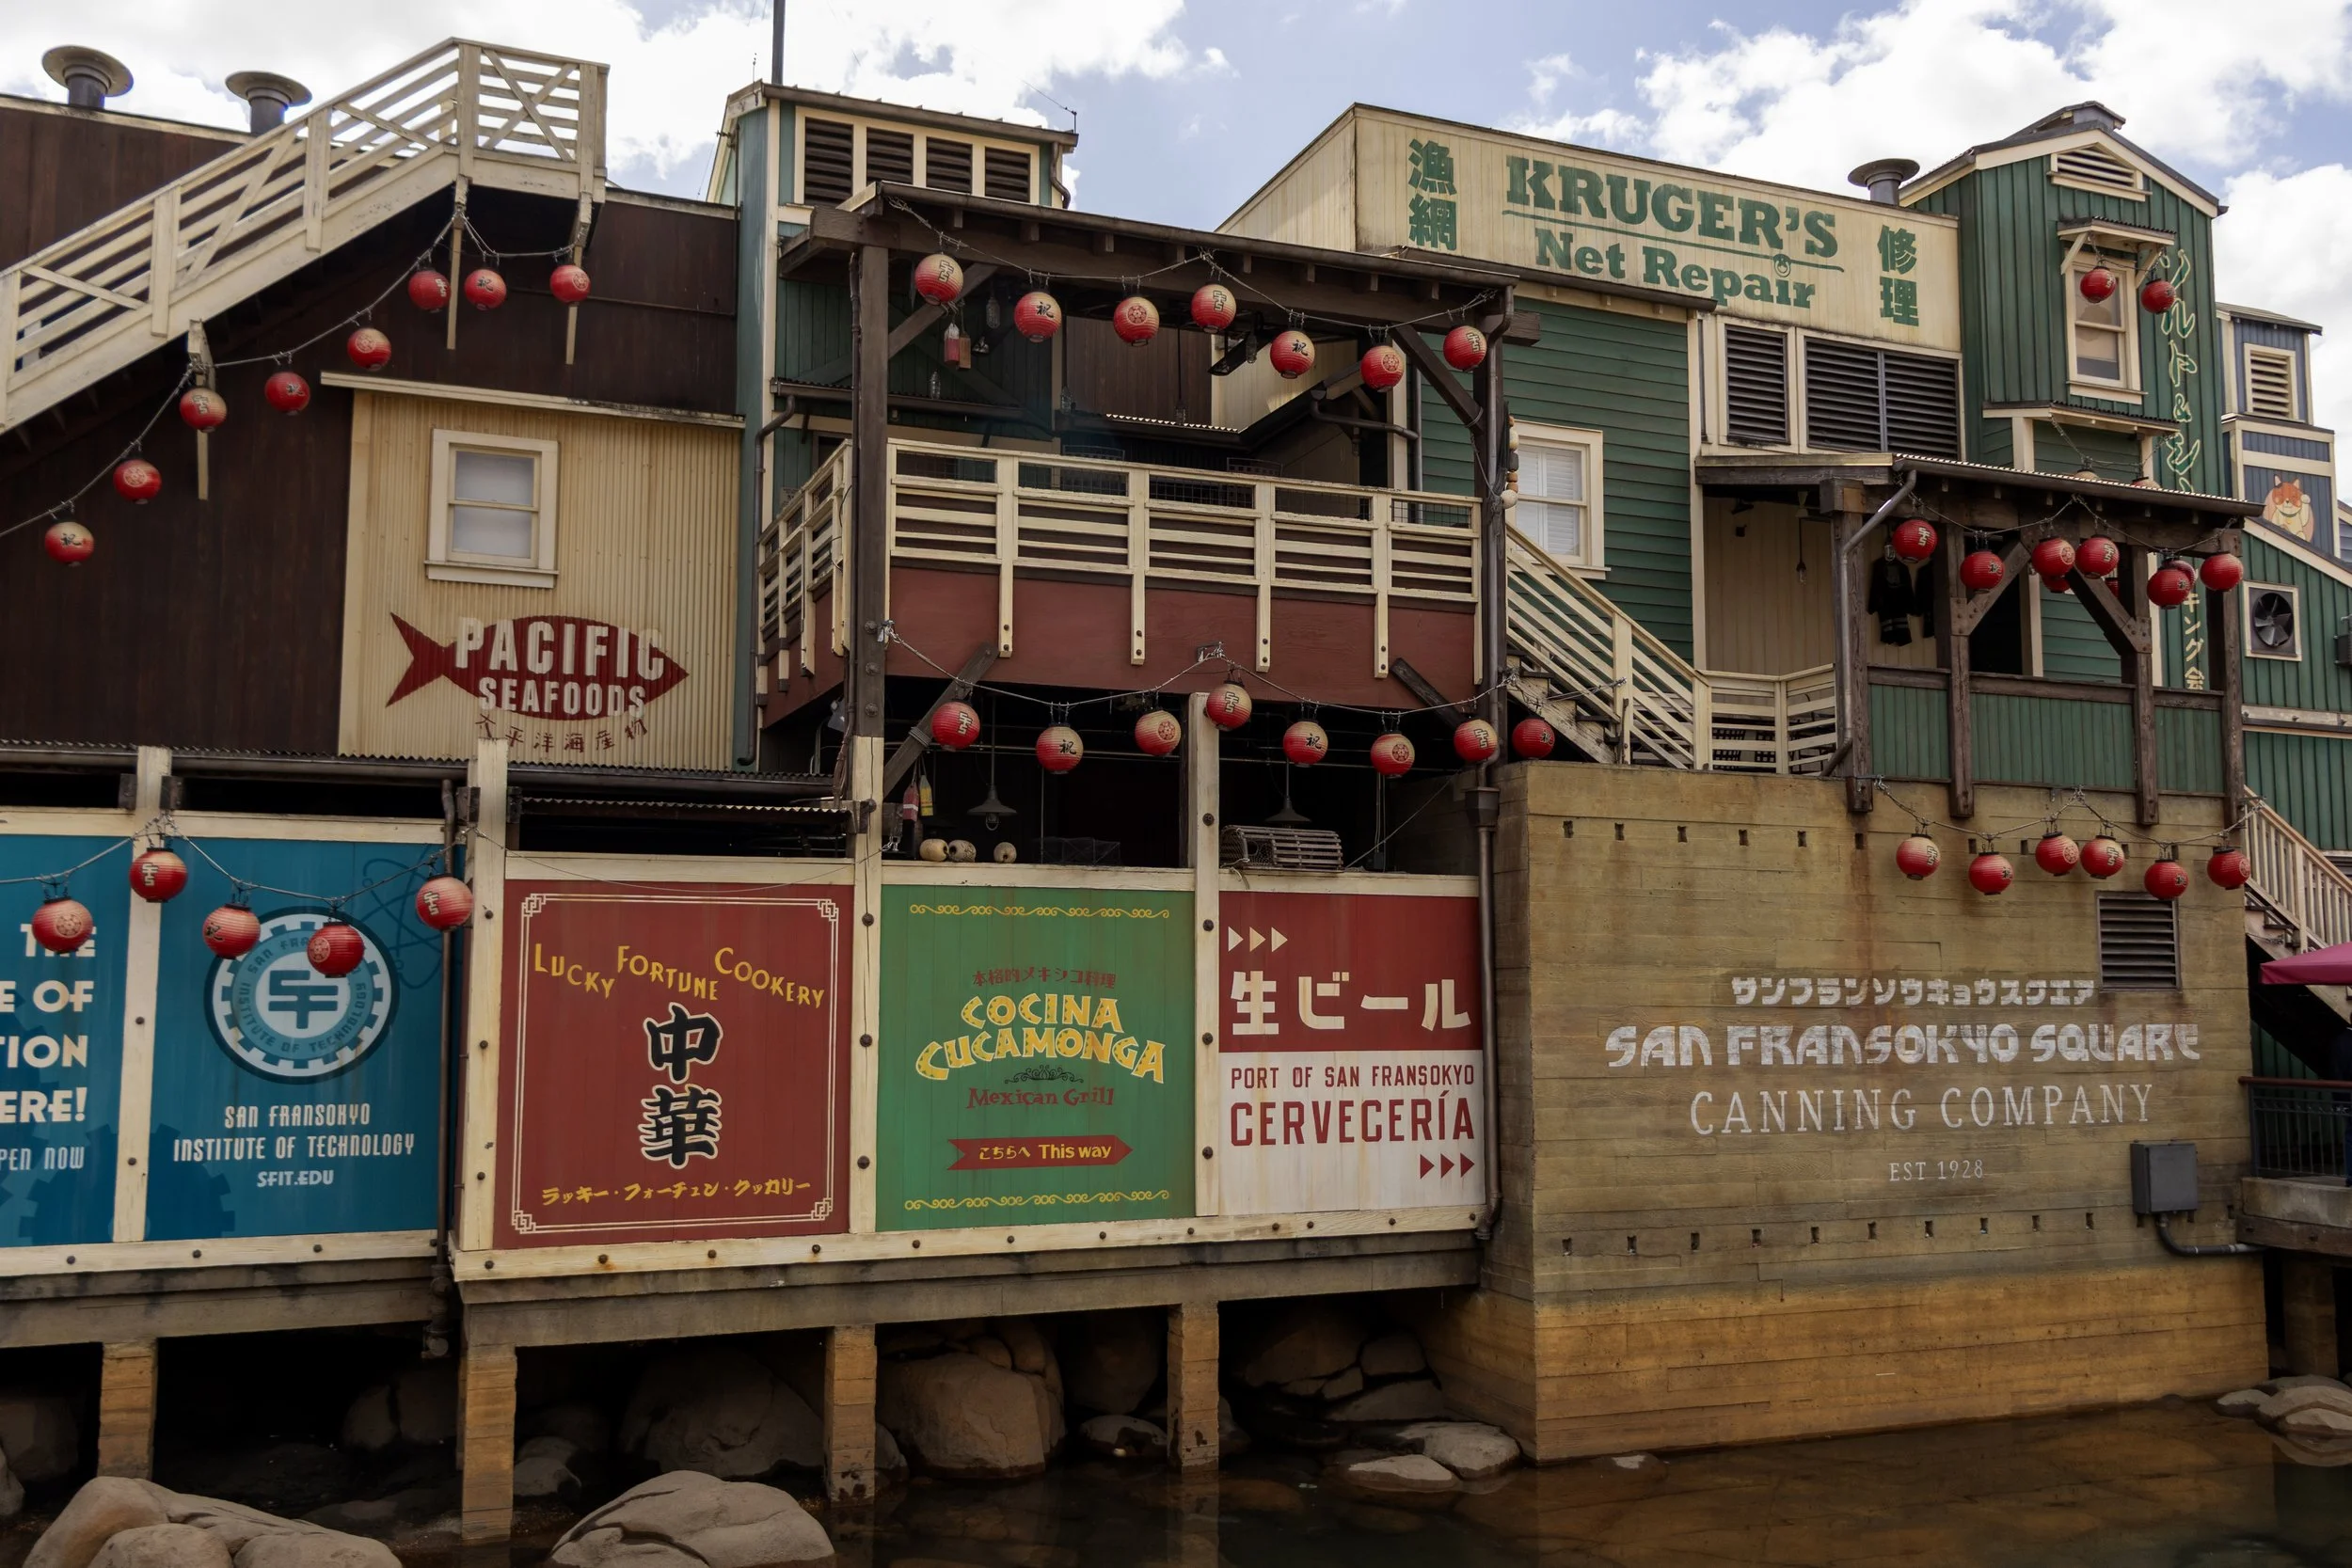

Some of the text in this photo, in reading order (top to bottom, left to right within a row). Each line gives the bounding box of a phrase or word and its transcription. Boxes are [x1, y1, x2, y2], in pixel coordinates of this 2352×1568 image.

[1534, 228, 1816, 309] Net Repair
[1877, 224, 1919, 327] 修理
[1036, 302, 1054, 319] 祝
[1292, 340, 1308, 356] 祝
[454, 616, 664, 681] PACIFIC
[478, 676, 645, 718] SEAFOODS
[1058, 739, 1076, 754] 祝
[1306, 733, 1321, 749] 祝
[248, 949, 273, 974] SAN
[533, 942, 825, 1008] LUCKY FORTUNE COOKERY
[972, 966, 1118, 989] 本格的メキシコ料理
[33, 980, 94, 1013] OF
[961, 992, 1125, 1034] COCINA
[1231, 970, 1471, 1036] 生ビール
[238, 982, 367, 1053] INSTITUTE OF TECHNOLOGY
[0, 1034, 88, 1069] ION
[914, 1027, 1167, 1085] CUCAMONGA
[1605, 1023, 2201, 1068] SAN FRANSOKYO SQUARE
[637, 1001, 723, 1169] 中華
[1231, 1064, 1474, 1089] PORT OF SAN FRANSOKYO
[966, 1086, 1115, 1109] Mexican Grill
[1691, 1083, 2153, 1135] CANNING COMPANY
[224, 1102, 371, 1129] SAN FRANSOKYO
[1231, 1090, 1475, 1147] CERVECERÍA
[44, 1146, 85, 1170] NOW
[173, 1133, 415, 1162] INSTITUTE OF TECHNOLOGY
[978, 1145, 1112, 1162] こちらへ This way
[256, 1169, 335, 1188] SFIT.EDU
[1889, 1159, 1984, 1182] EST 1928
